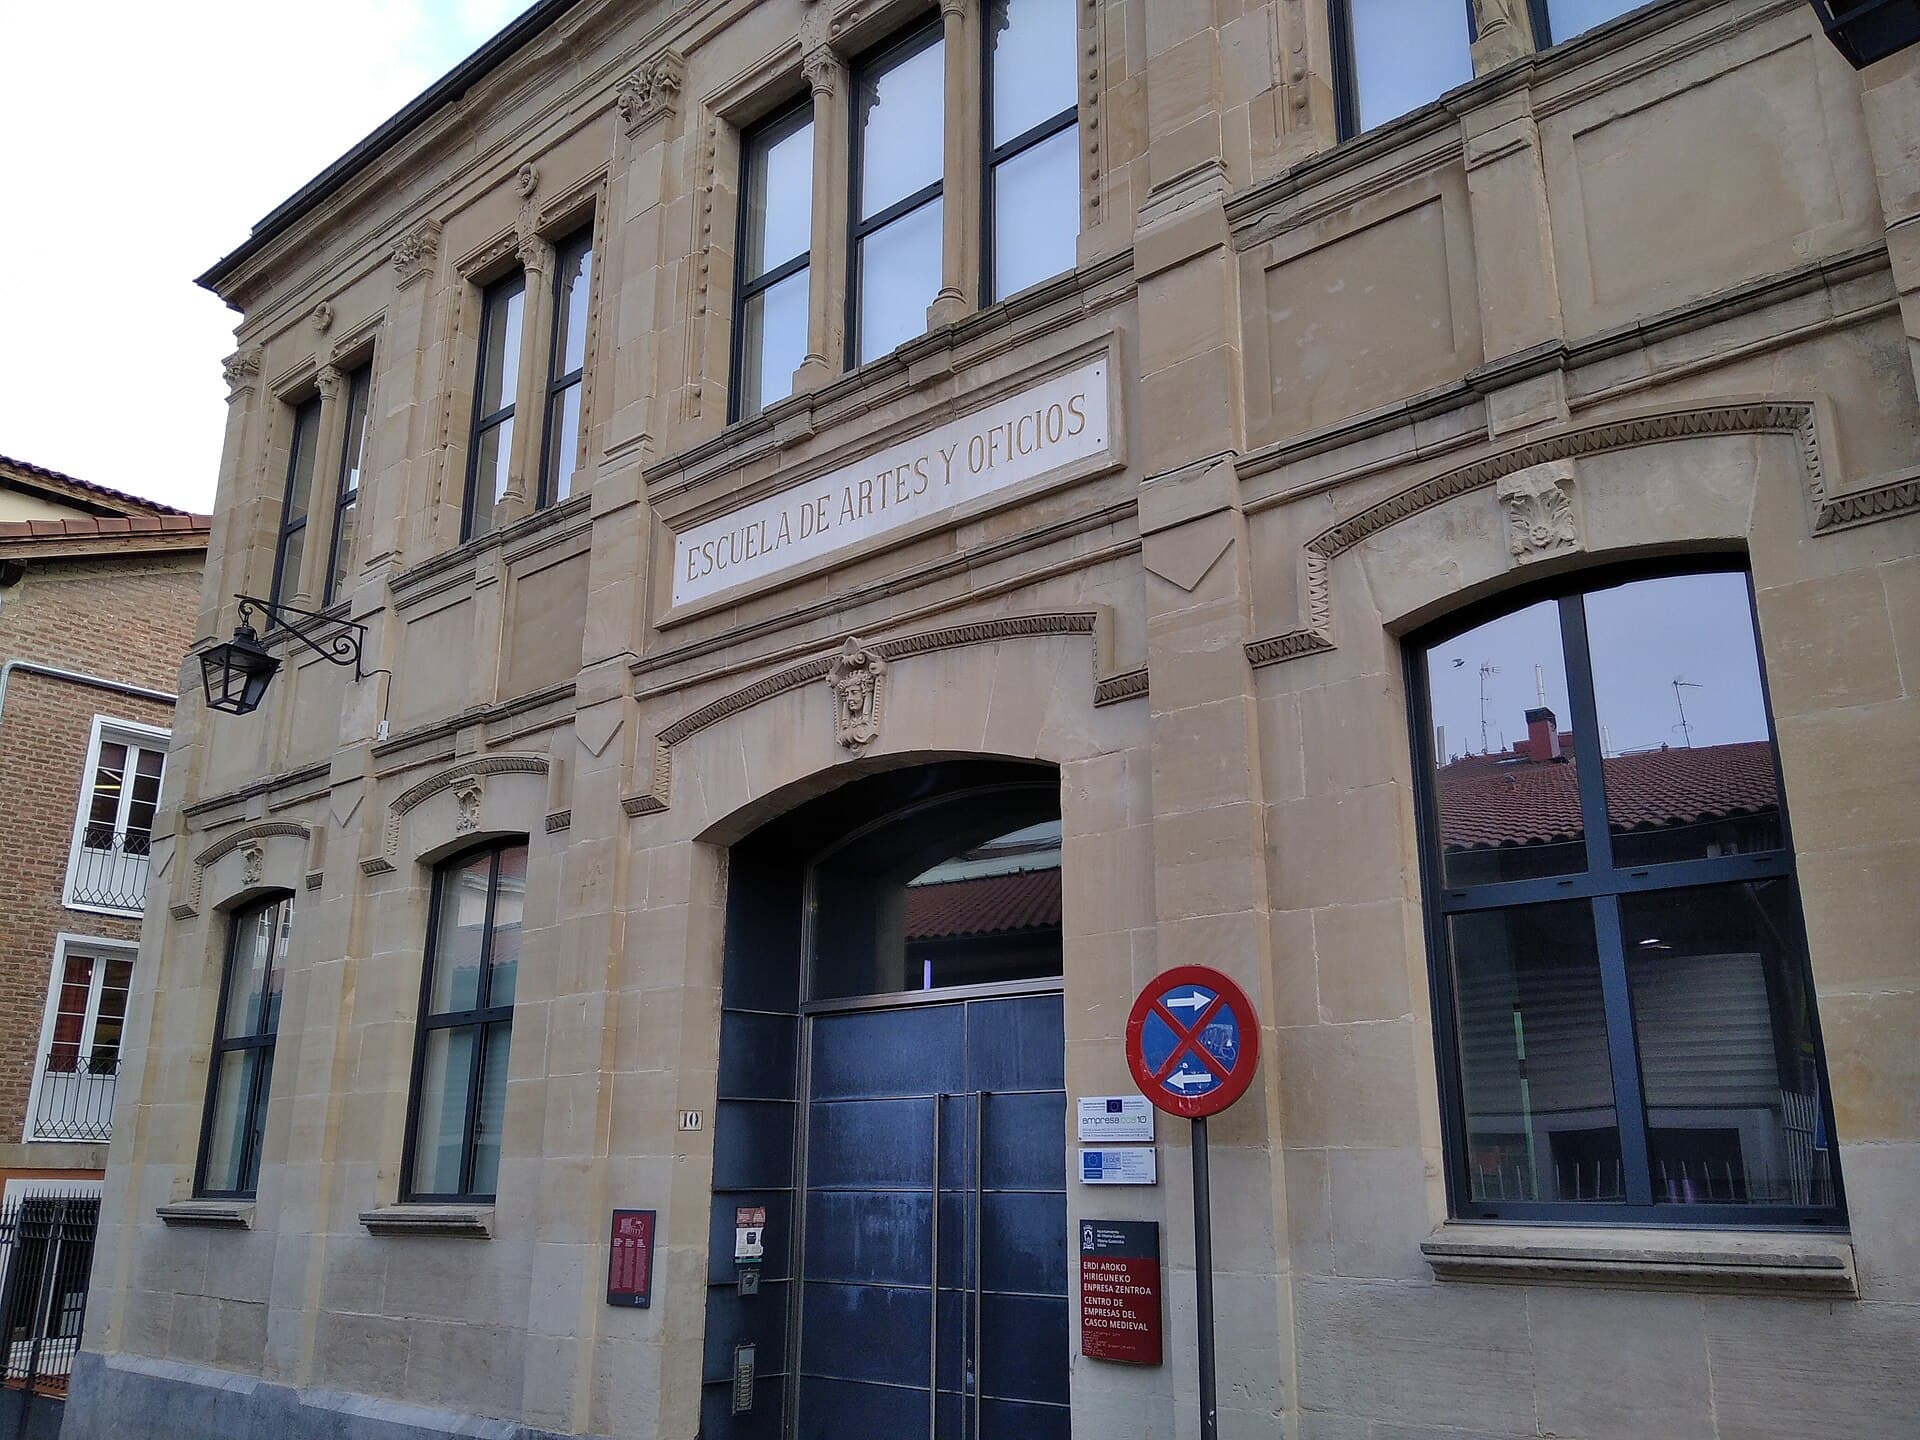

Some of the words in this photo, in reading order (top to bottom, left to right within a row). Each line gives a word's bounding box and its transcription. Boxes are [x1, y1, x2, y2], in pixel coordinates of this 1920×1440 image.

[686, 512, 792, 583] ESCUELA
[800, 494, 831, 540] DE
[838, 455, 929, 526] ARTES
[939, 443, 959, 485] Y
[967, 393, 1087, 475] OFICIOS
[683, 1112, 699, 1127] 10
[1083, 1261, 1099, 1270] ERDI
[1100, 1262, 1127, 1272] AROKO
[1083, 1272, 1131, 1283] HIRIGUNEKO
[1083, 1283, 1114, 1293] ENPRESA
[1115, 1285, 1152, 1295] ZENTROA
[1084, 1296, 1112, 1306] CENTRO
[1113, 1298, 1124, 1307] DE
[1084, 1307, 1120, 1318] EMPRESAS
[1122, 1310, 1137, 1319] DEL
[1084, 1318, 1108, 1328] CASCO
[1109, 1320, 1149, 1331] MEDIEVAL
